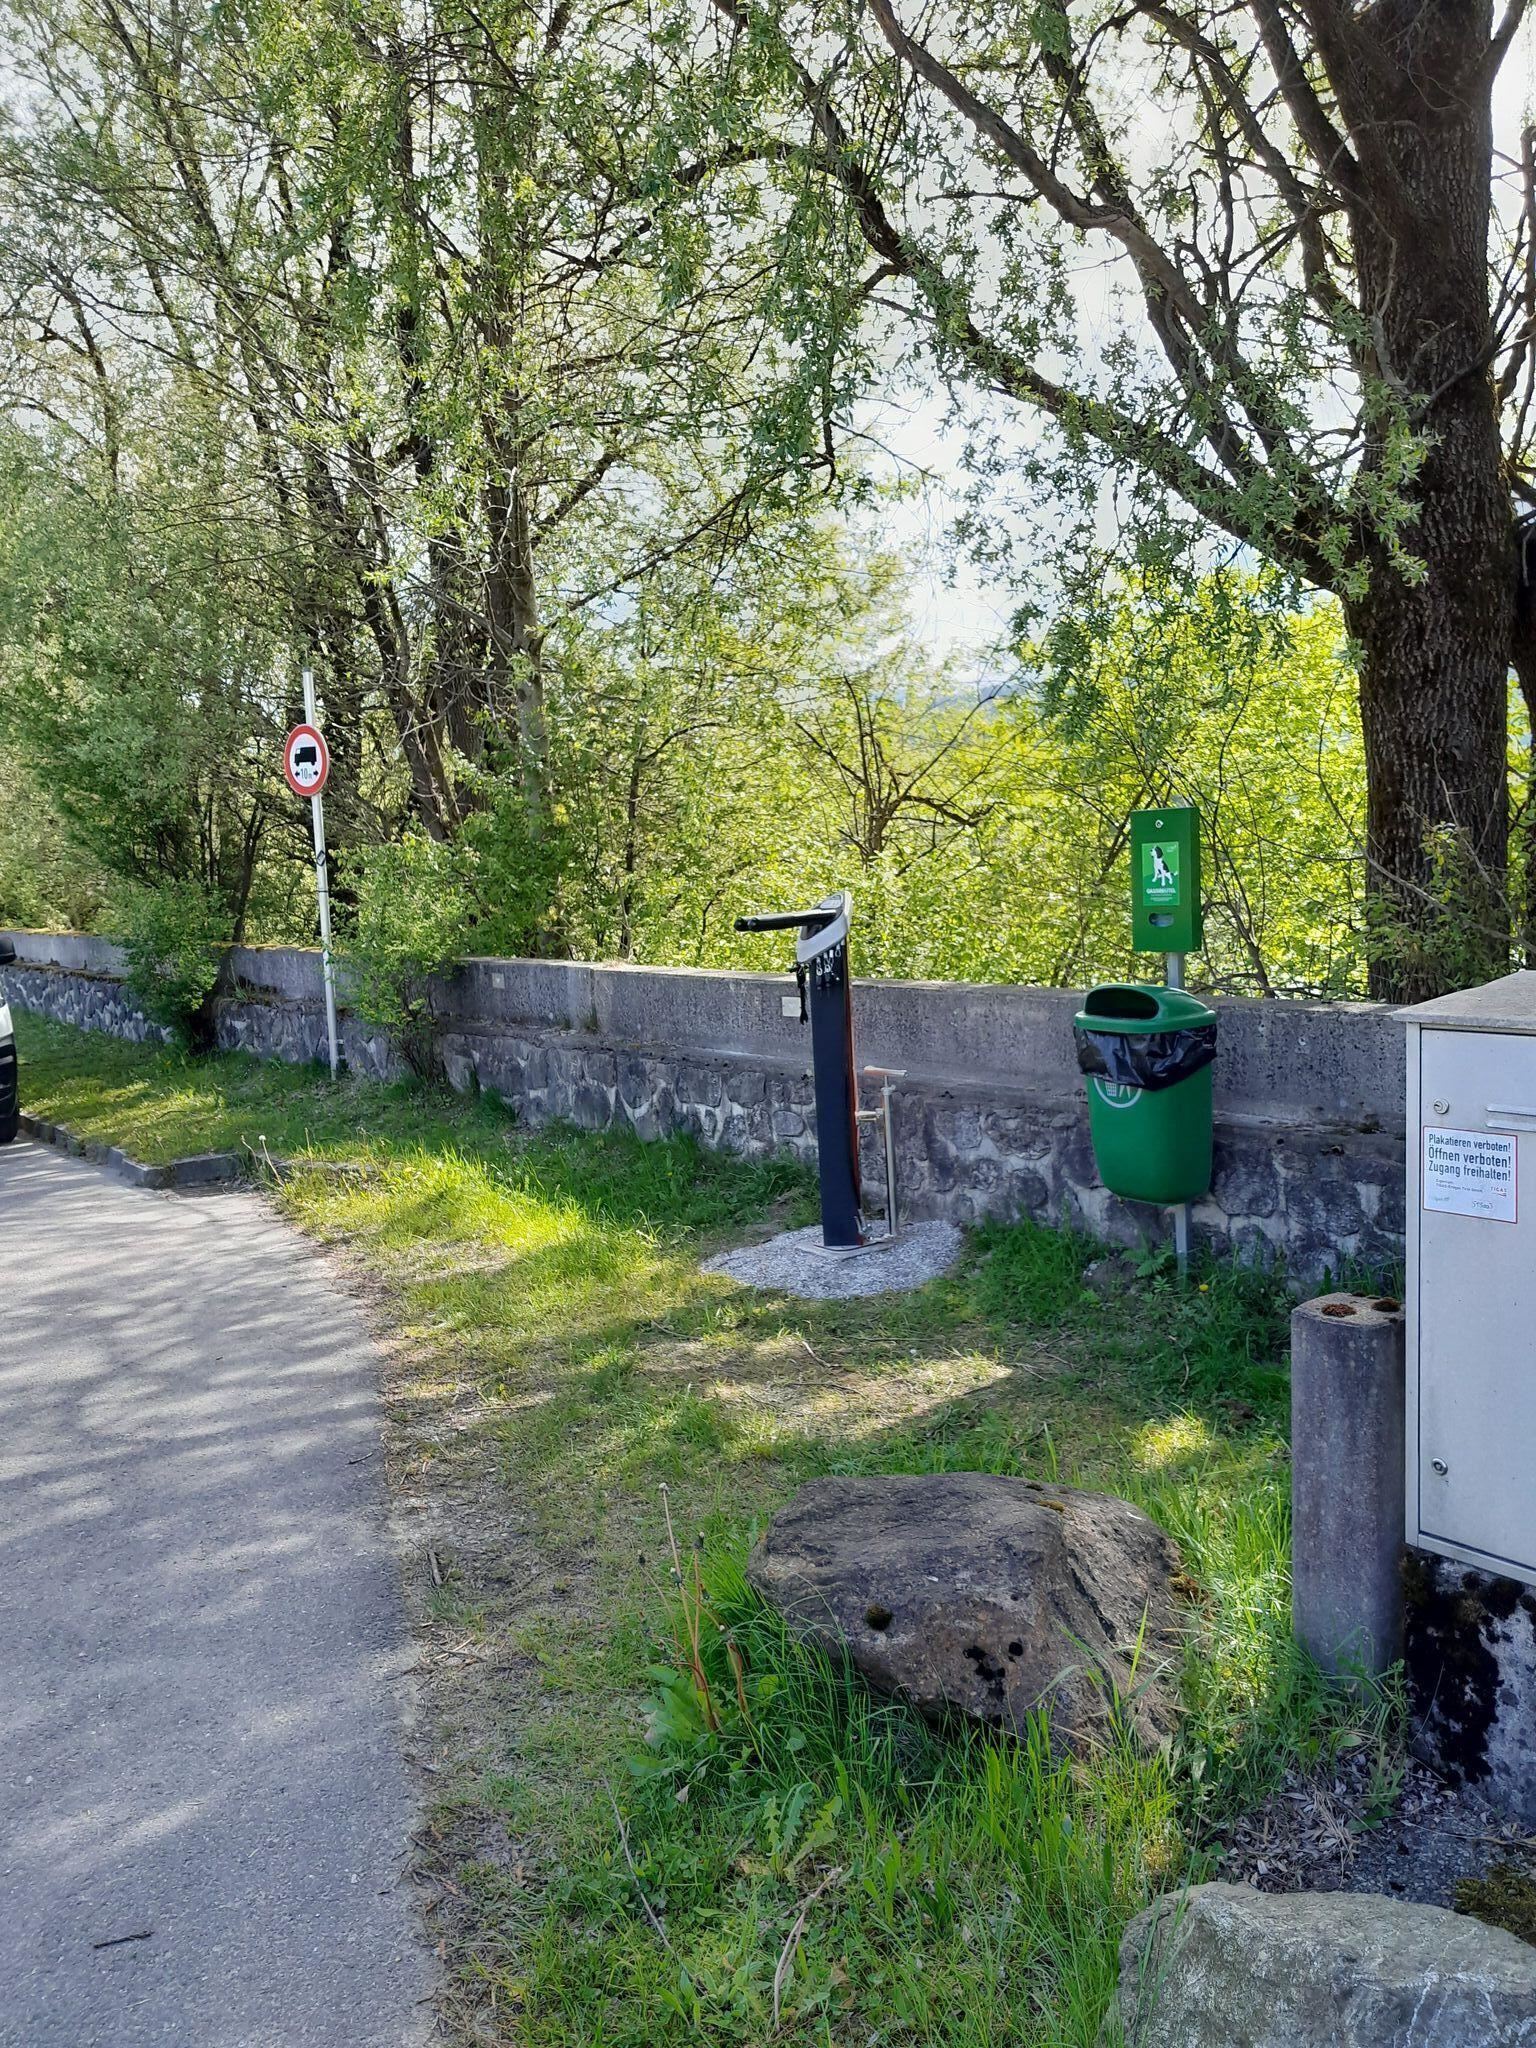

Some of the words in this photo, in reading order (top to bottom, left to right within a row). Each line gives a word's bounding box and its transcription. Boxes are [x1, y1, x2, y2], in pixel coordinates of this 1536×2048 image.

[1428, 1134, 1472, 1148] Plakatieren
[1474, 1140, 1510, 1152] verboten!
[1428, 1144, 1460, 1162] Öffnen
[1464, 1153, 1511, 1168] verboten!
[1428, 1160, 1460, 1177] Zugang
[1464, 1165, 1511, 1182] freihalten!
